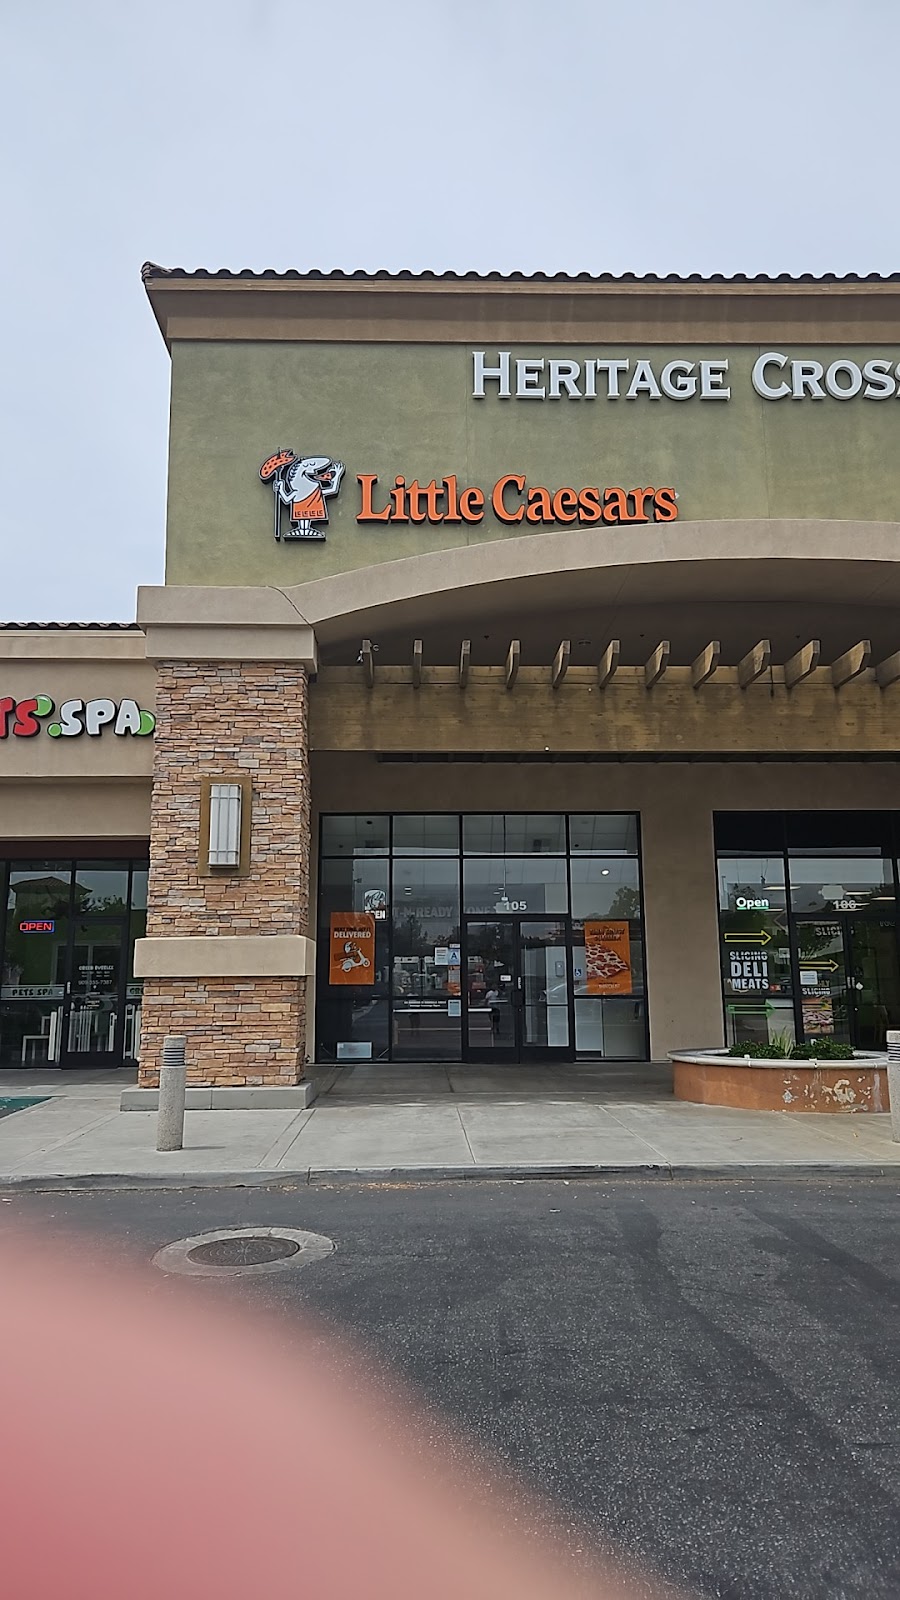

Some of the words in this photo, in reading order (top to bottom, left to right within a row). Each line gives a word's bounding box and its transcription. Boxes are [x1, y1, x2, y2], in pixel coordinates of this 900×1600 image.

[472, 351, 731, 400] HERITAGE
[751, 352, 900, 400] CROS
[356, 474, 485, 523] Little
[493, 475, 679, 523] Caesars
[60, 699, 142, 736] SPA
[503, 901, 527, 911] 105
[736, 897, 769, 909] Open
[19, 922, 53, 931] OPEN
[333, 931, 372, 939] DELIVERED
[729, 951, 768, 960] SLICING
[731, 961, 769, 977] DELI
[732, 978, 770, 989] MEATS
[12, 988, 34, 996] PETS
[37, 988, 54, 996] SPA
